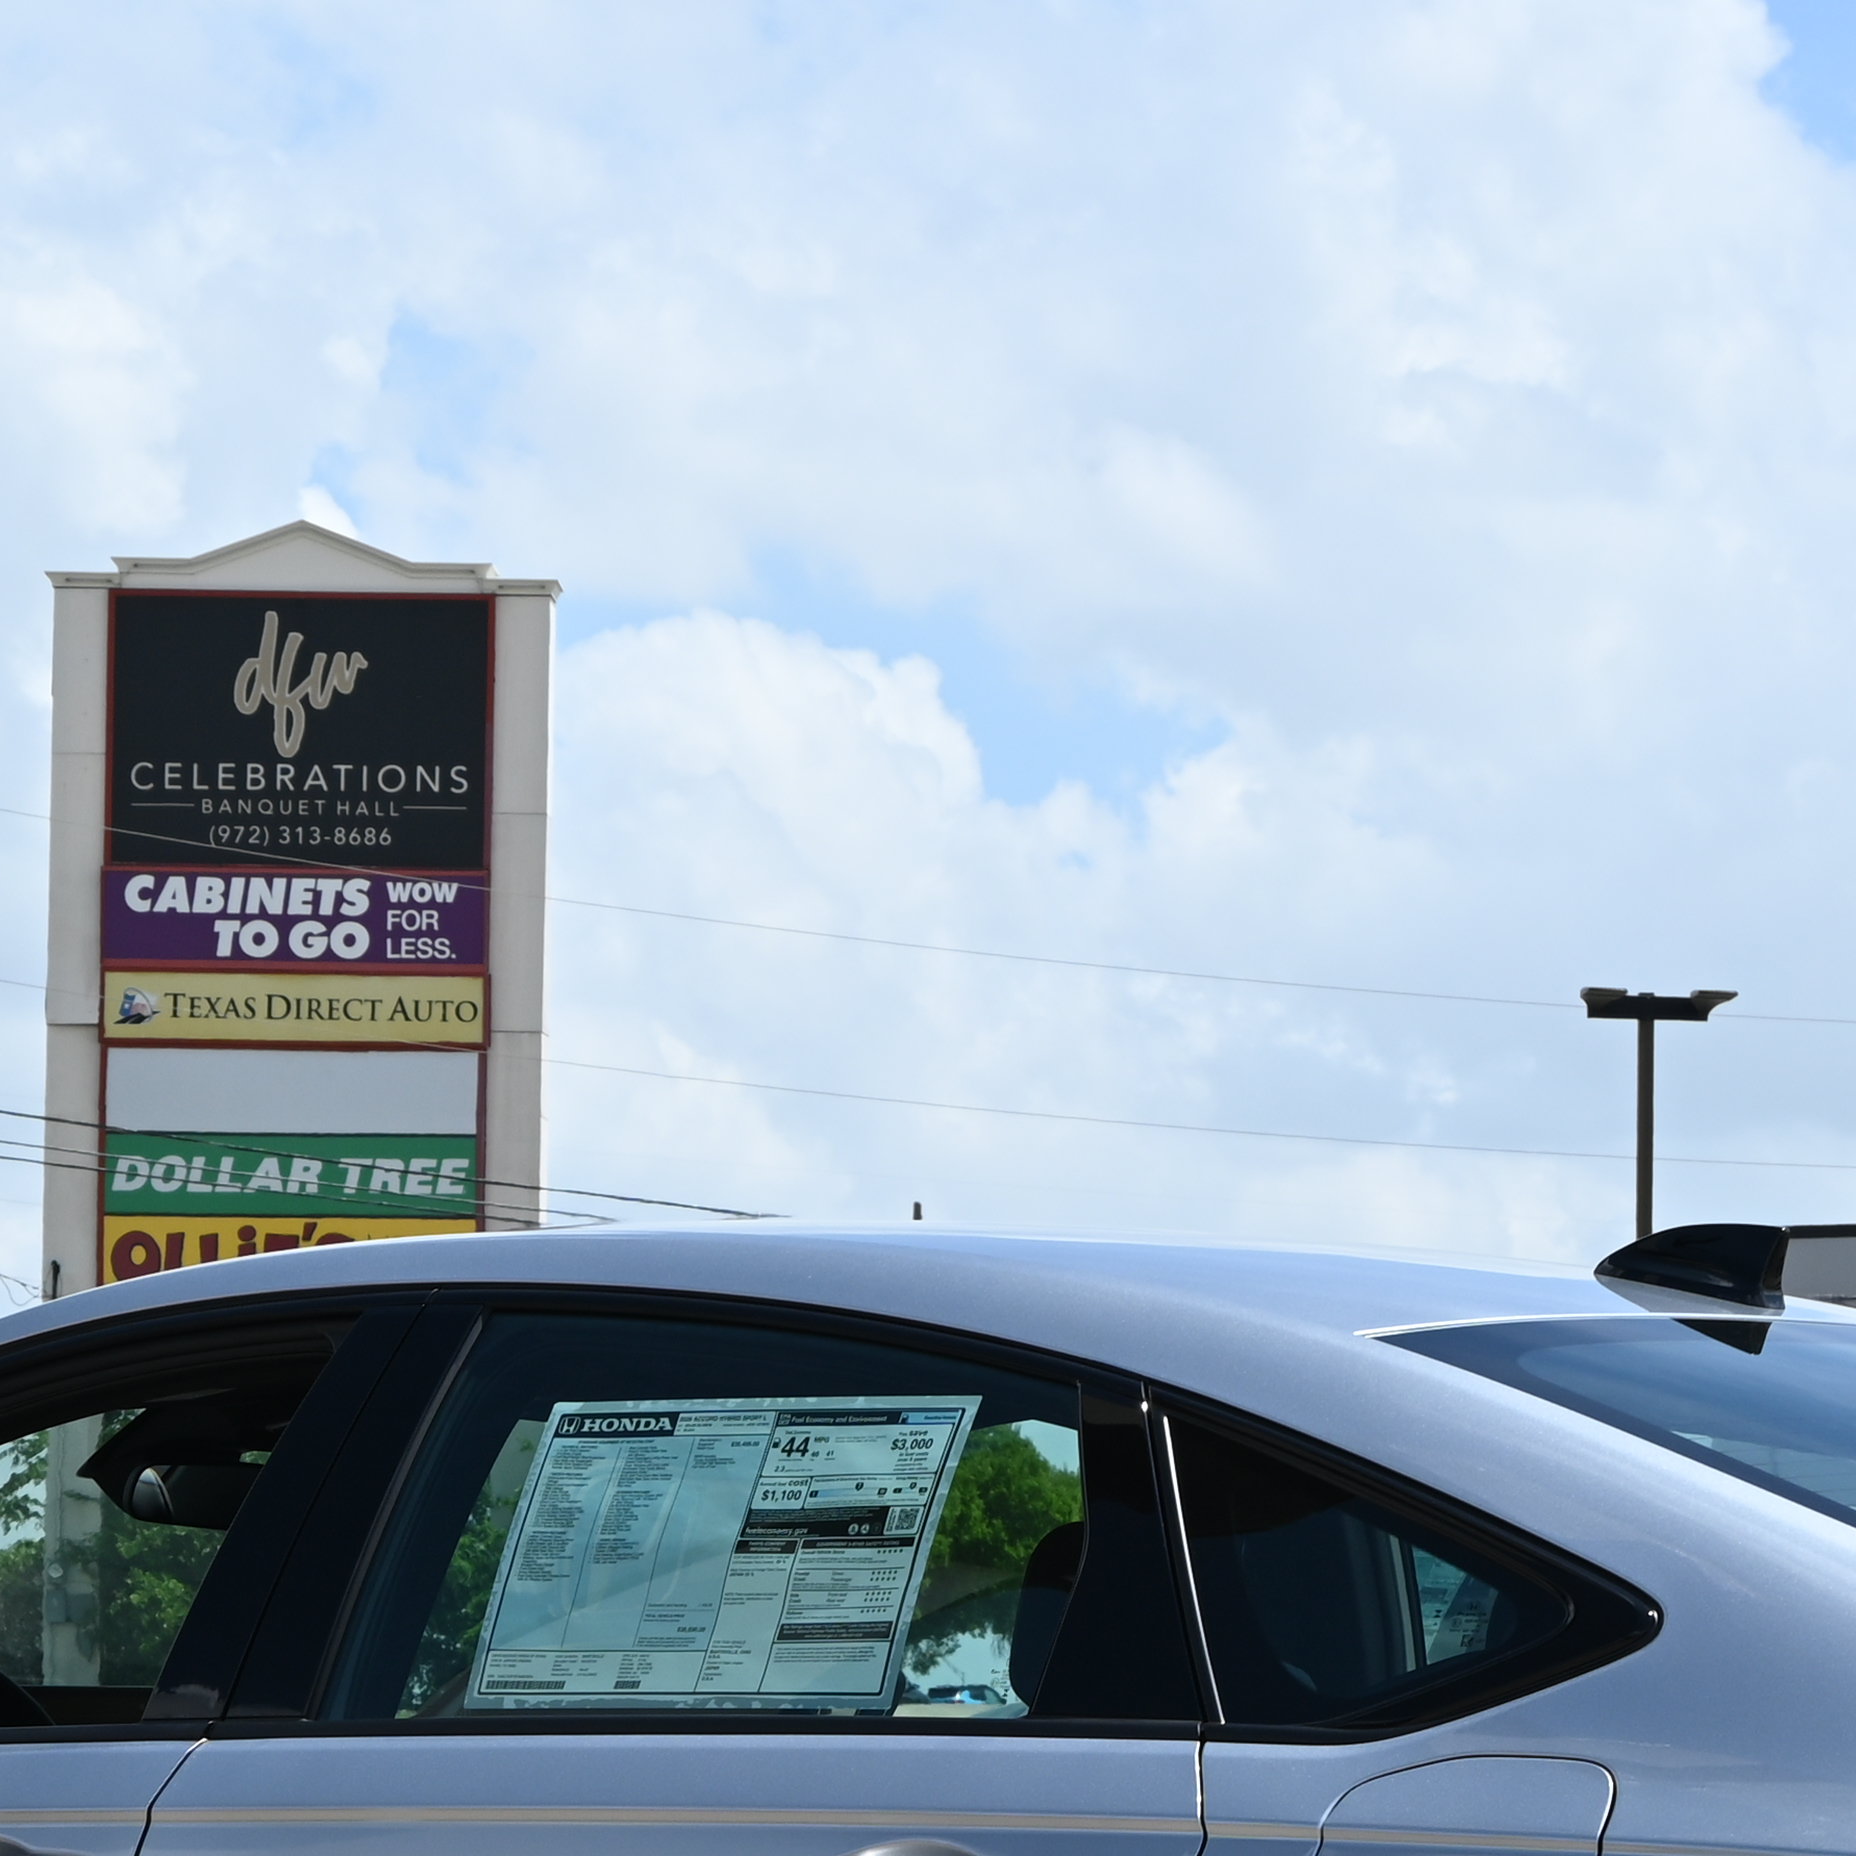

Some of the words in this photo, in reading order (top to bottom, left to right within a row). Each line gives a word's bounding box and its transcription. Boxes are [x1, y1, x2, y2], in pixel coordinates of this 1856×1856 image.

[233, 611, 369, 758] dfw
[129, 762, 470, 794] CELEBRATIONS
[201, 798, 327, 816] BANQUET
[336, 800, 401, 816] HALL
[208, 825, 269, 847] (972)
[278, 826, 393, 846] 313-8686
[124, 874, 372, 917] CABINETS
[386, 881, 459, 903] WOW
[386, 909, 440, 931] FOR
[214, 919, 280, 958] TO
[287, 920, 372, 960] GO
[386, 937, 457, 960] LESS.
[163, 992, 257, 1020] TEXAS
[265, 993, 383, 1021] DIRECT
[389, 996, 479, 1023] AUTO
[111, 1153, 322, 1196] DOLLAR
[339, 1156, 470, 1196] TREE
[581, 1417, 673, 1433] HONDA
[780, 1436, 810, 1457] 44
[890, 1438, 934, 1451] $3,000
[761, 1489, 803, 1503] $1,100
